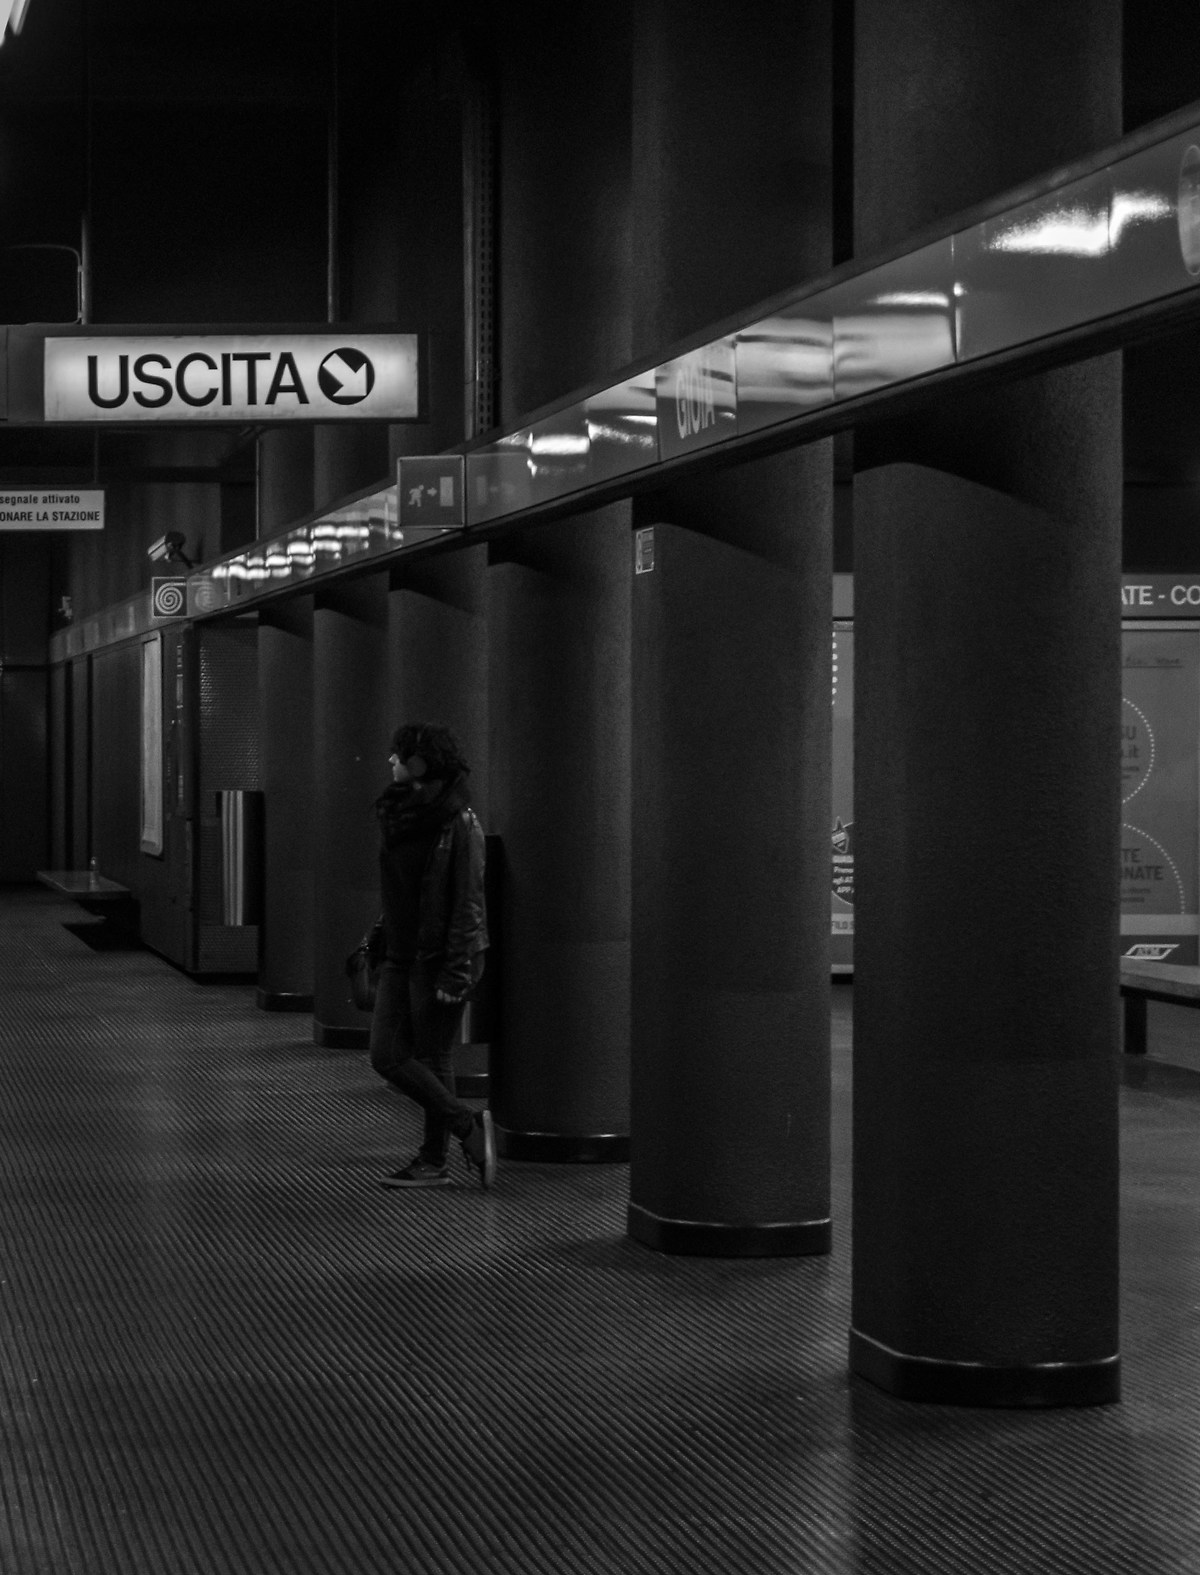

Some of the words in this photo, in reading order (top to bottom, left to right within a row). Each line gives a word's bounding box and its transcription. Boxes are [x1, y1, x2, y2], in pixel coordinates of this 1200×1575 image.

[87, 351, 310, 409] USCITA
[42, 494, 80, 504] attivato
[36, 511, 49, 522] LA
[52, 510, 100, 522] STAZIONE
